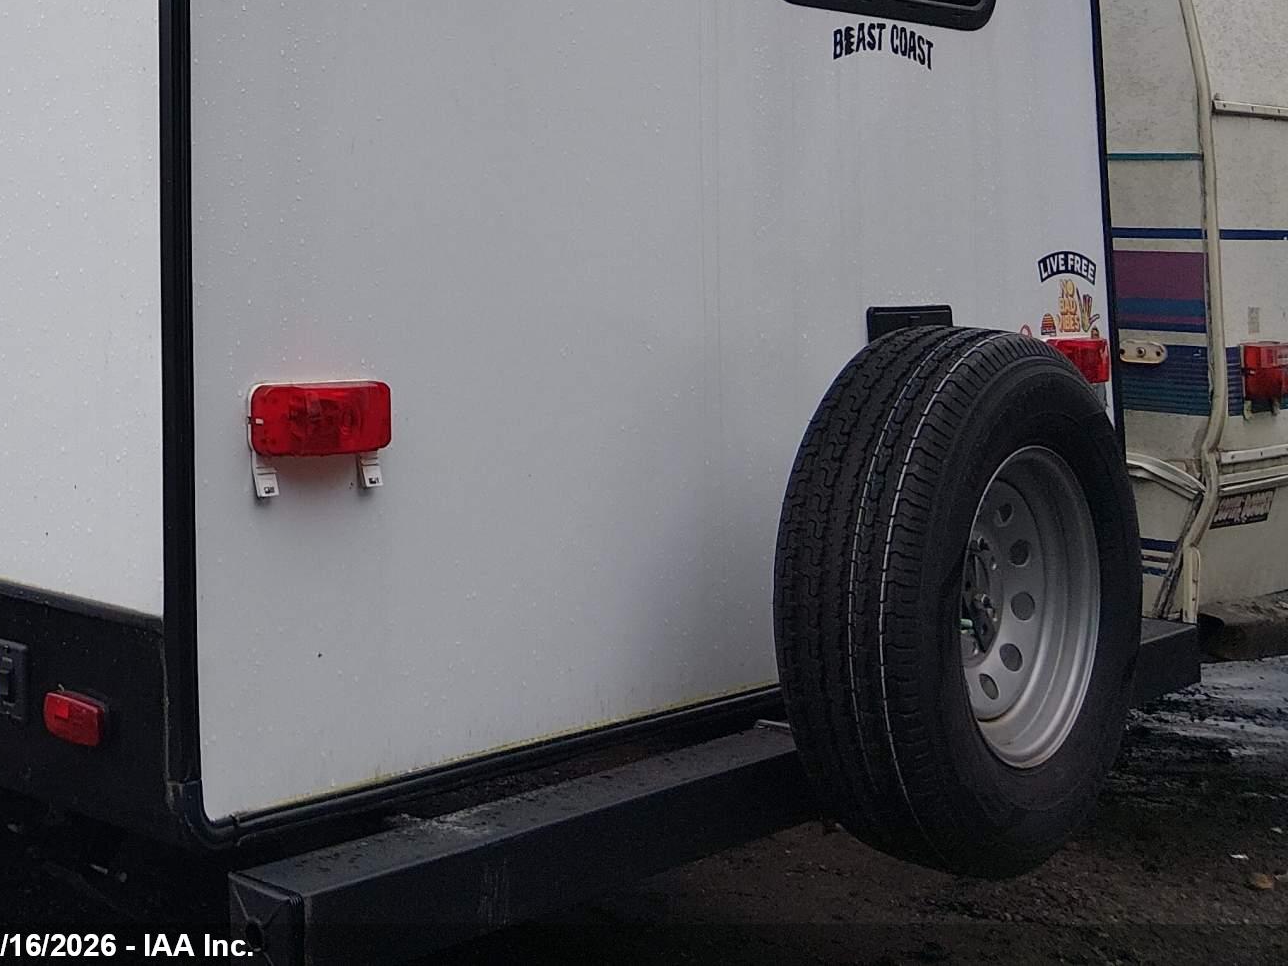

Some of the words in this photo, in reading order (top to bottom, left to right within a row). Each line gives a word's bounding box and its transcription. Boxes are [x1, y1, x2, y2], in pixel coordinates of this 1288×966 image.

[833, 22, 886, 60] BEAST
[890, 24, 934, 70] COAST
[1040, 254, 1066, 279] LIVE
[1067, 254, 1095, 283] FREE
[1058, 297, 1077, 315] BAD
